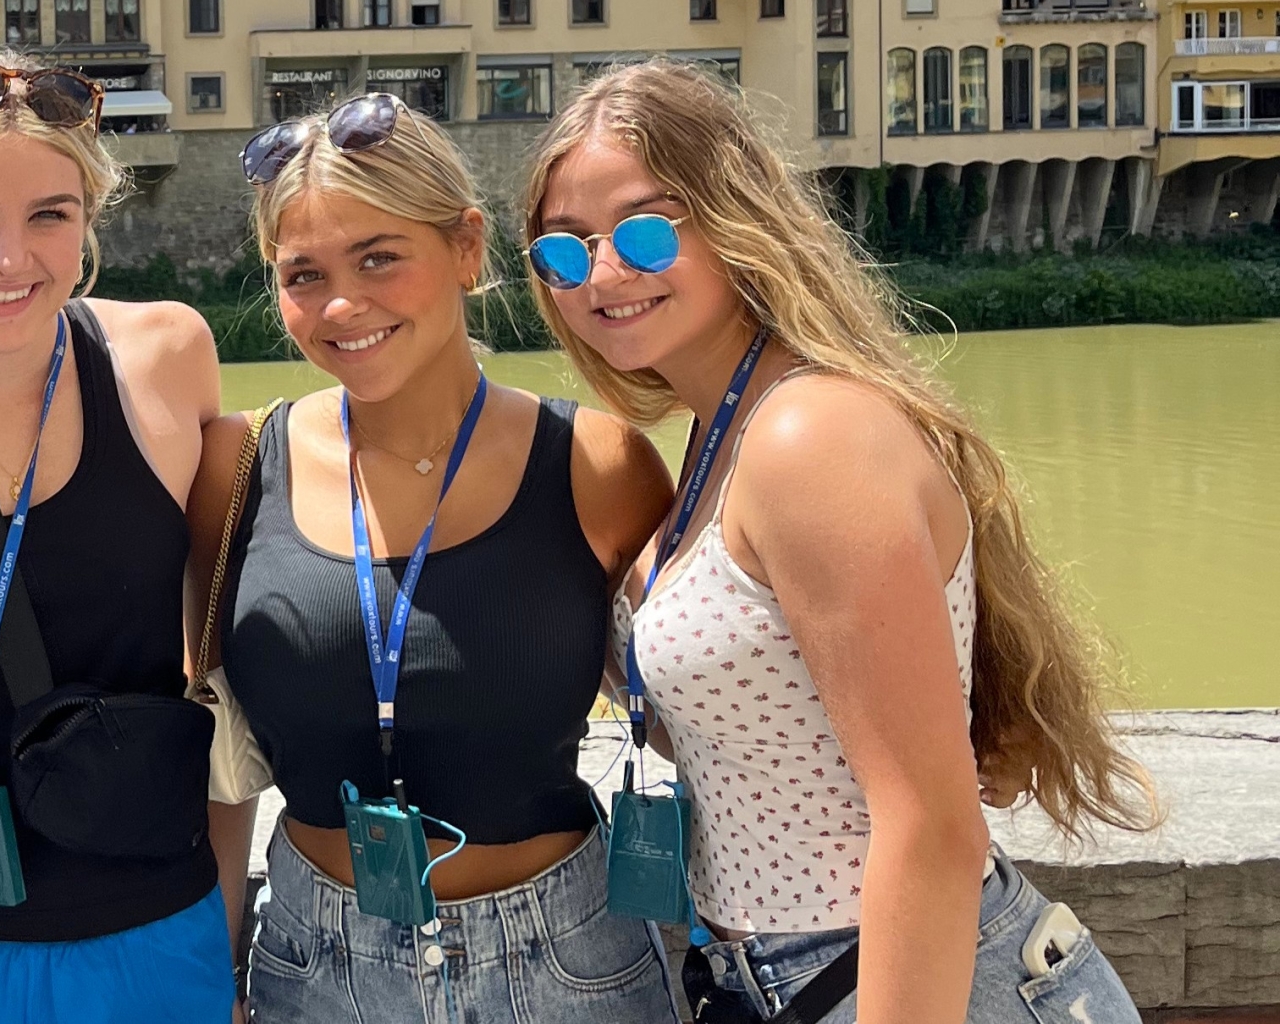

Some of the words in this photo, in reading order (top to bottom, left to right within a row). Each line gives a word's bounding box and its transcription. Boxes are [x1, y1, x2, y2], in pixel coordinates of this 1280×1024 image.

[272, 70, 333, 82] RESTAURANT
[367, 68, 441, 80] SIGNORVINO
[685, 428, 720, 512] www.voxtours.com
[363, 576, 381, 664] www.voxtours.com
